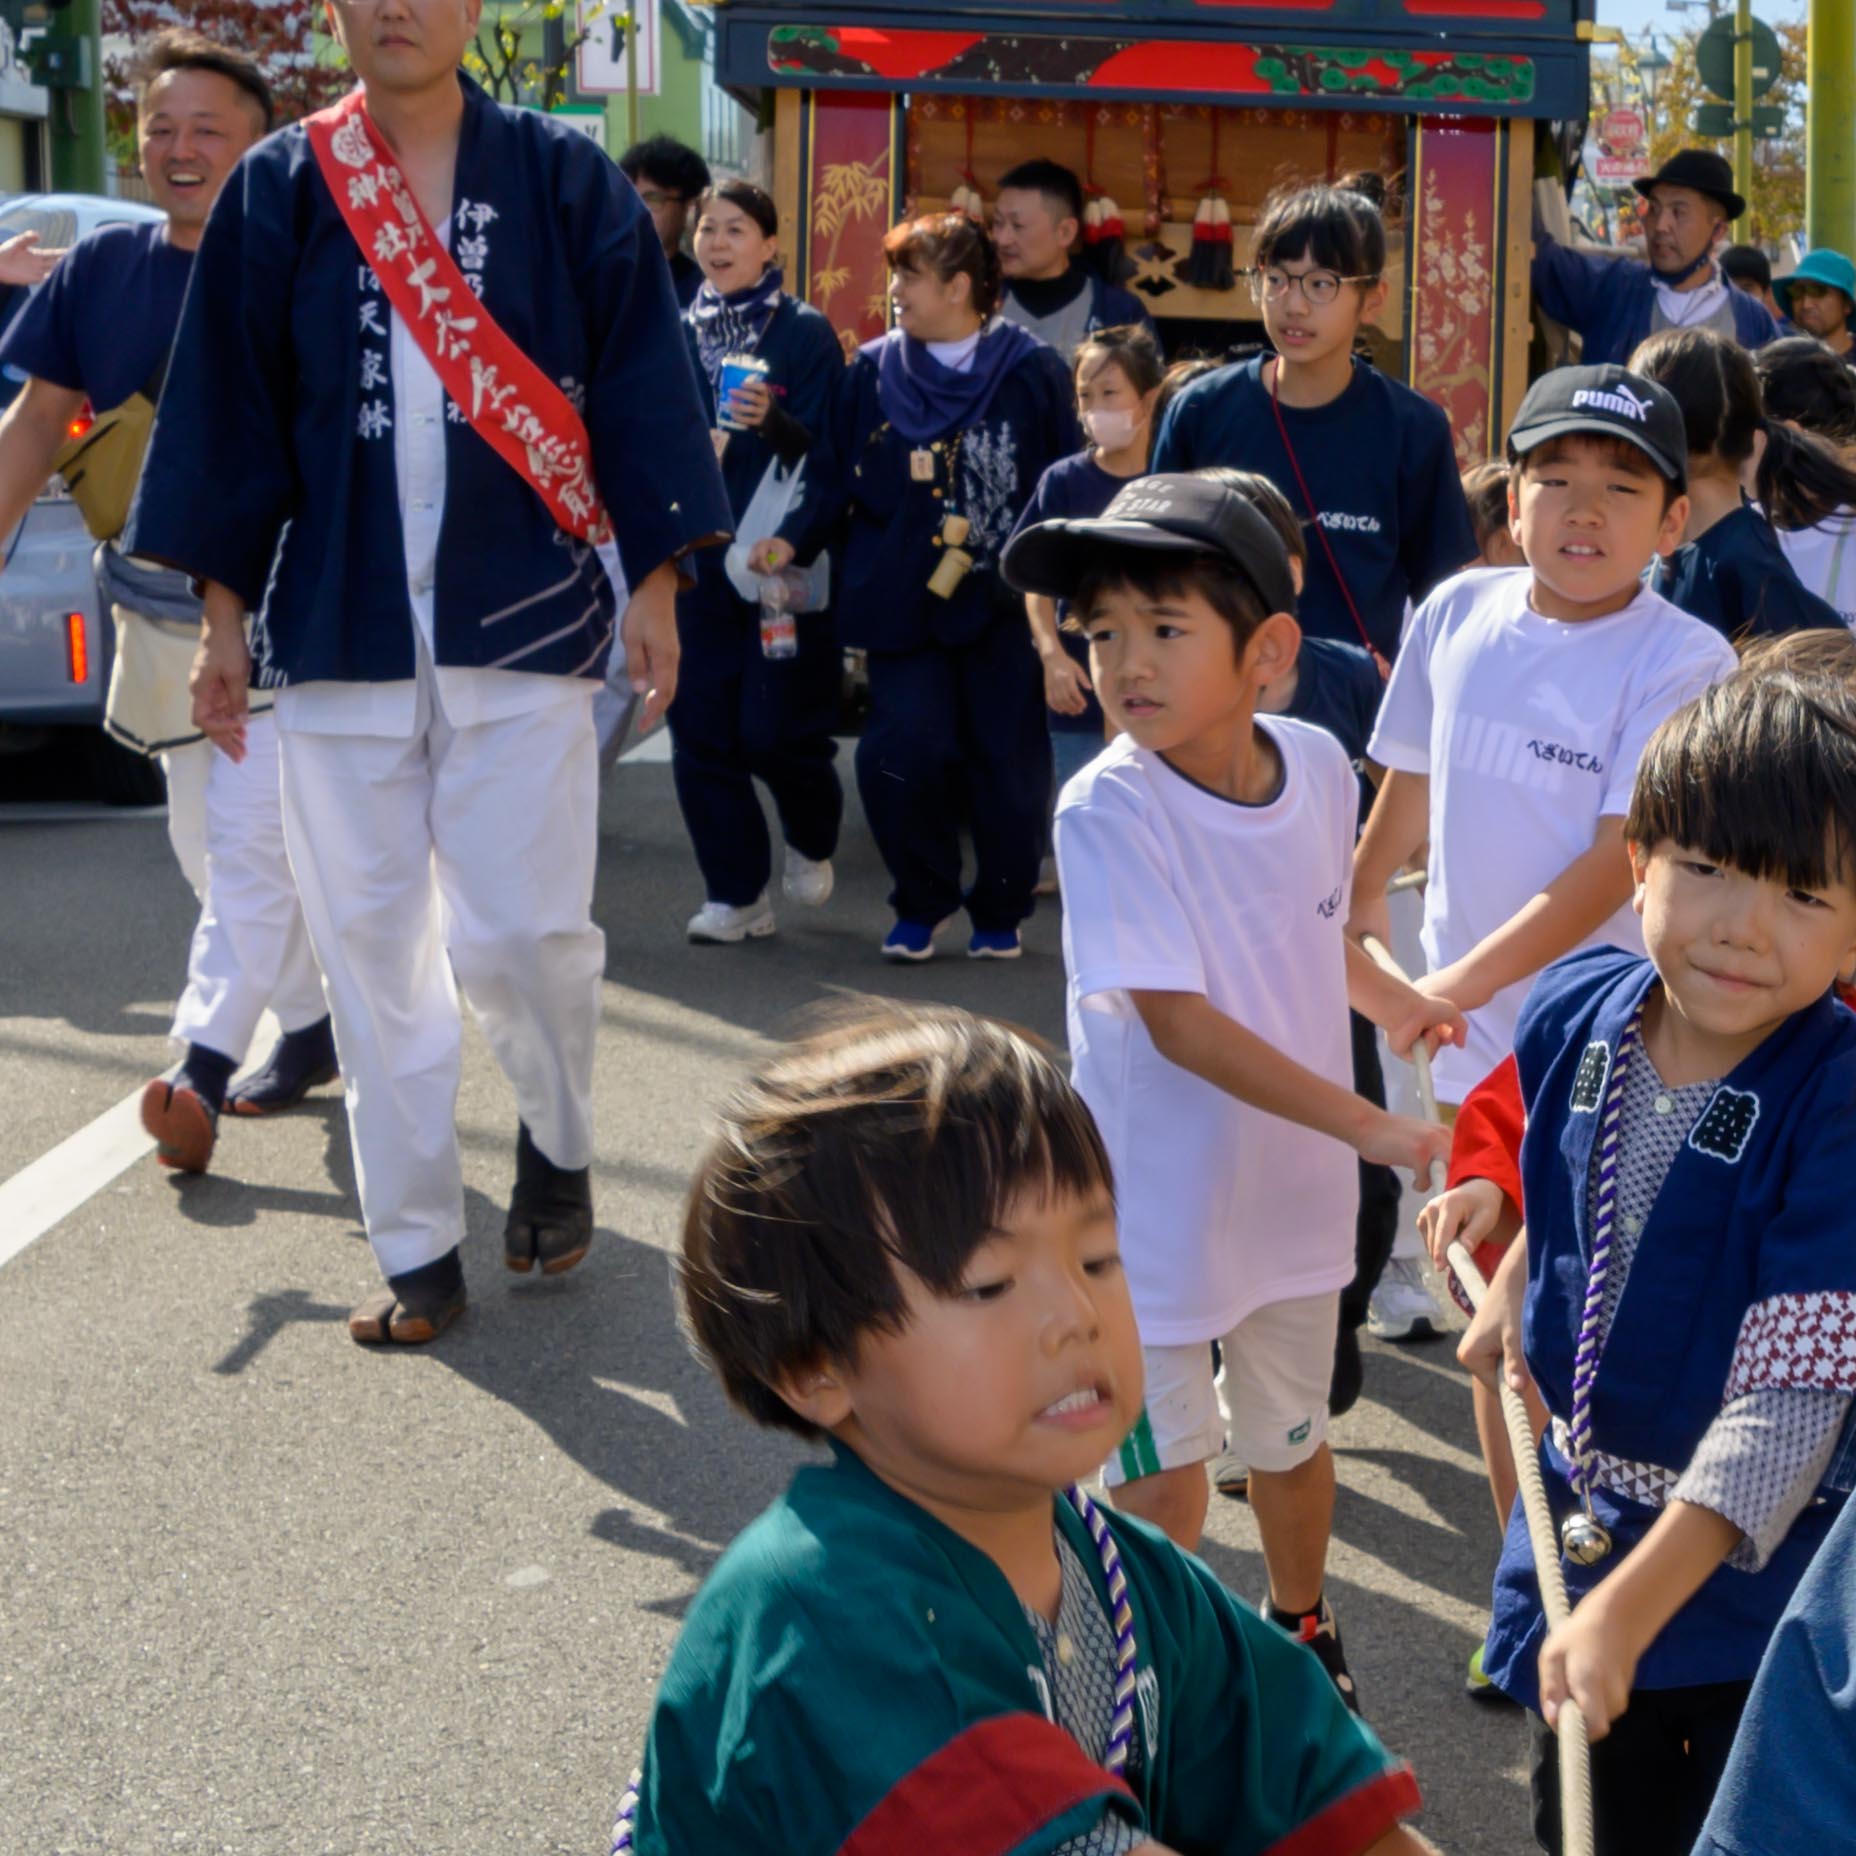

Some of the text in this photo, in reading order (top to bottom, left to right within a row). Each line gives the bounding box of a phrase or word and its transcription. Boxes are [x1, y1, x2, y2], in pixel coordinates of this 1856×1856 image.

[1572, 389, 1637, 419] PUMA
[1526, 738, 1603, 775] べざいてん
